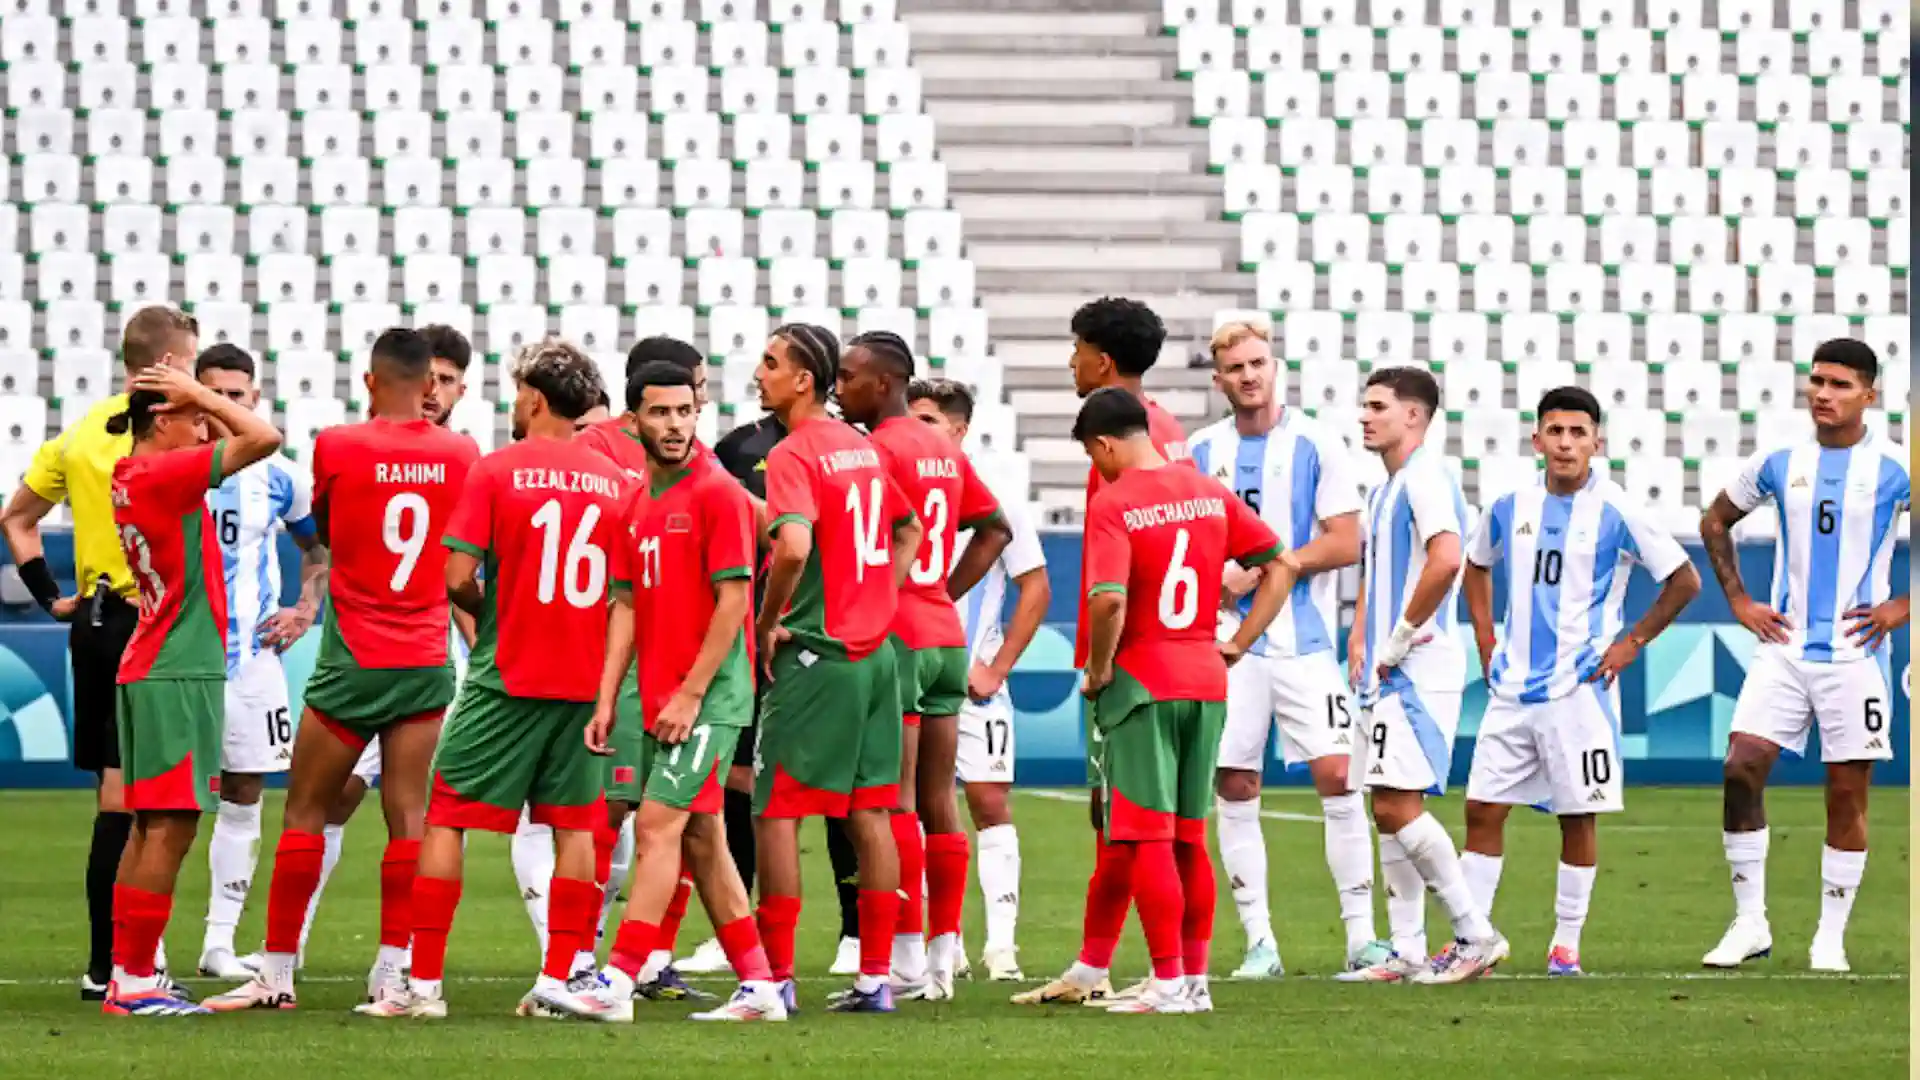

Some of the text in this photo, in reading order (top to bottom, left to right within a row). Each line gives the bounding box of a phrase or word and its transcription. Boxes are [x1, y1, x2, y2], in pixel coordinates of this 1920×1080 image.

[375, 463, 446, 484] RAHIMI
[1236, 487, 1260, 515] 5
[1819, 500, 1836, 534] 6
[382, 491, 430, 592] 9
[845, 478, 890, 584] 14
[909, 487, 949, 585] 3
[530, 498, 607, 609] 16
[639, 535, 661, 588] 11
[1533, 548, 1563, 585] 10
[1158, 528, 1198, 630] 6
[266, 706, 292, 746] 16
[1326, 693, 1352, 729] 15
[1864, 697, 1883, 733] 6
[985, 719, 1008, 756] 17
[1373, 722, 1388, 759] 9
[1582, 748, 1610, 787] 10
